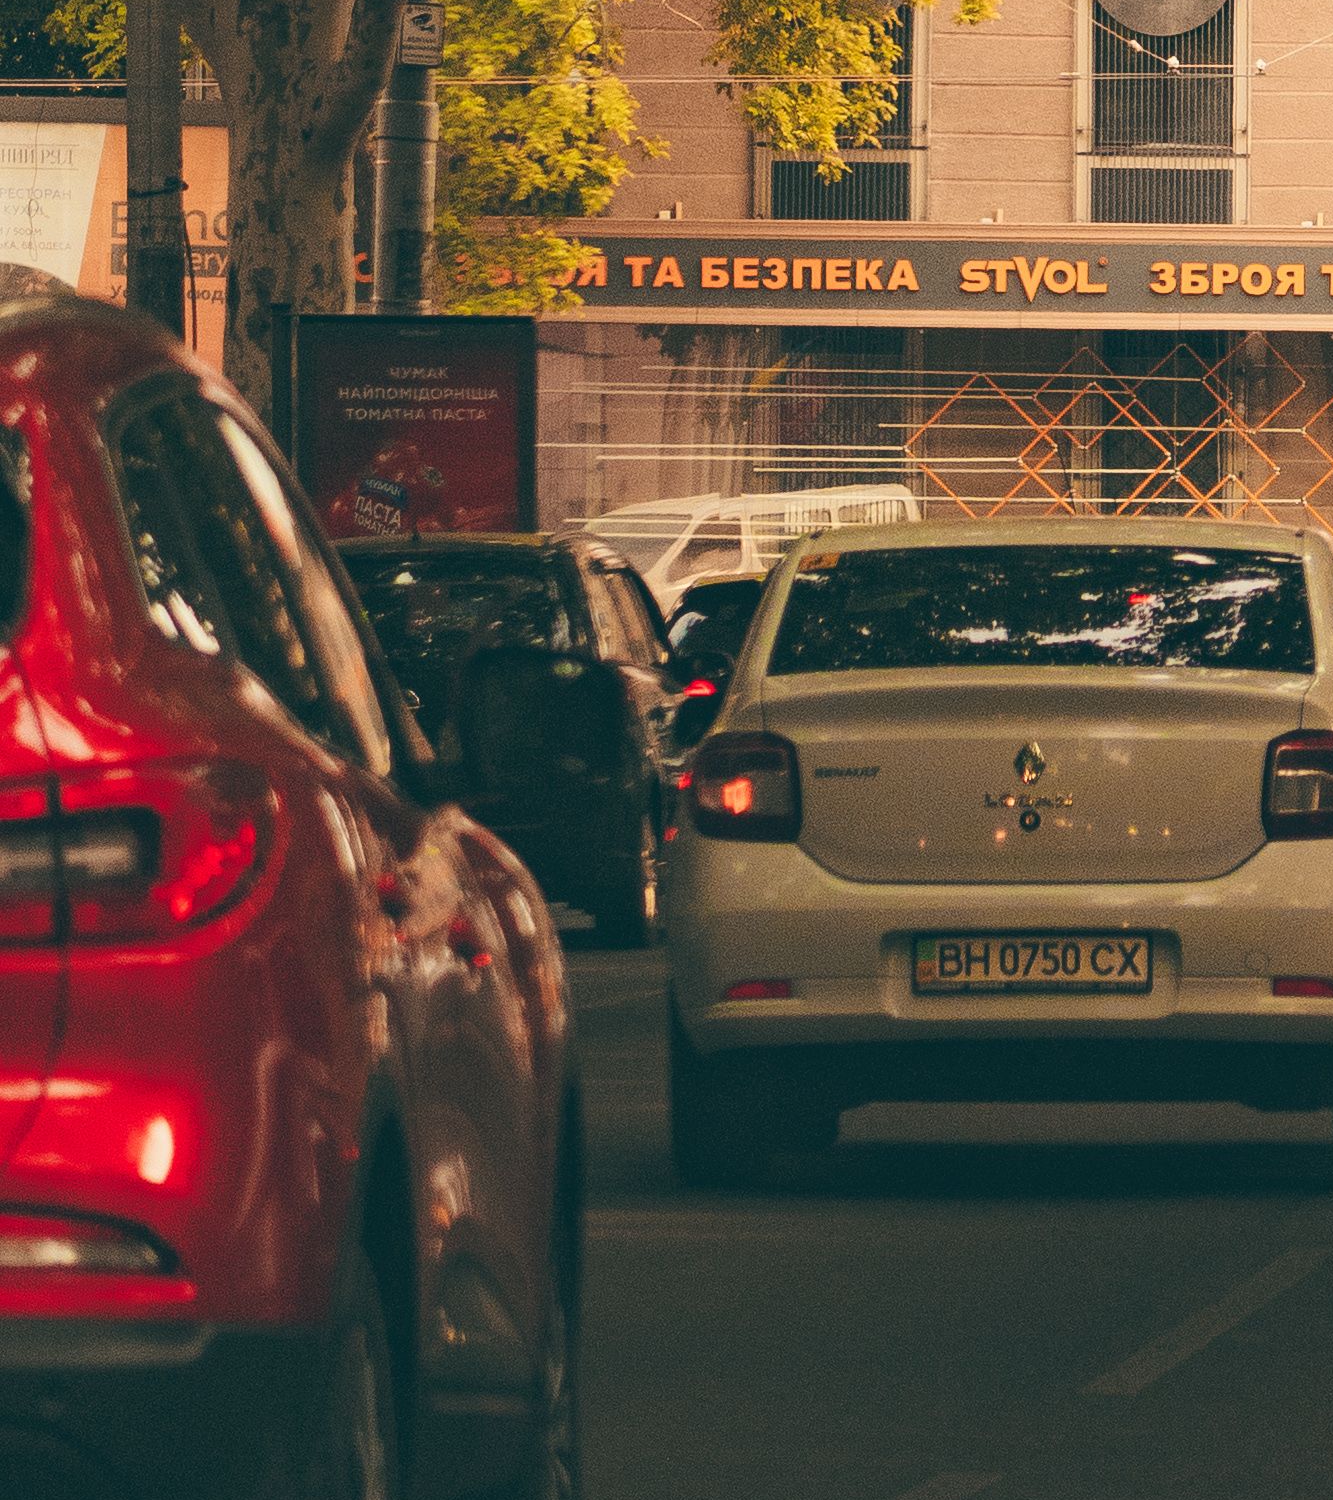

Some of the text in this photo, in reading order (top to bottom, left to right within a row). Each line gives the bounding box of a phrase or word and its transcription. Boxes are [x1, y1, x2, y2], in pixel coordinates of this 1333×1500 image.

[624, 256, 685, 289] ТА
[700, 256, 921, 292] БЕЗПЕКА
[1149, 261, 1305, 297] ЗБРОЯ
[432, 408, 488, 421] ПАСТА
[939, 941, 1142, 978] BH 0750 CX
